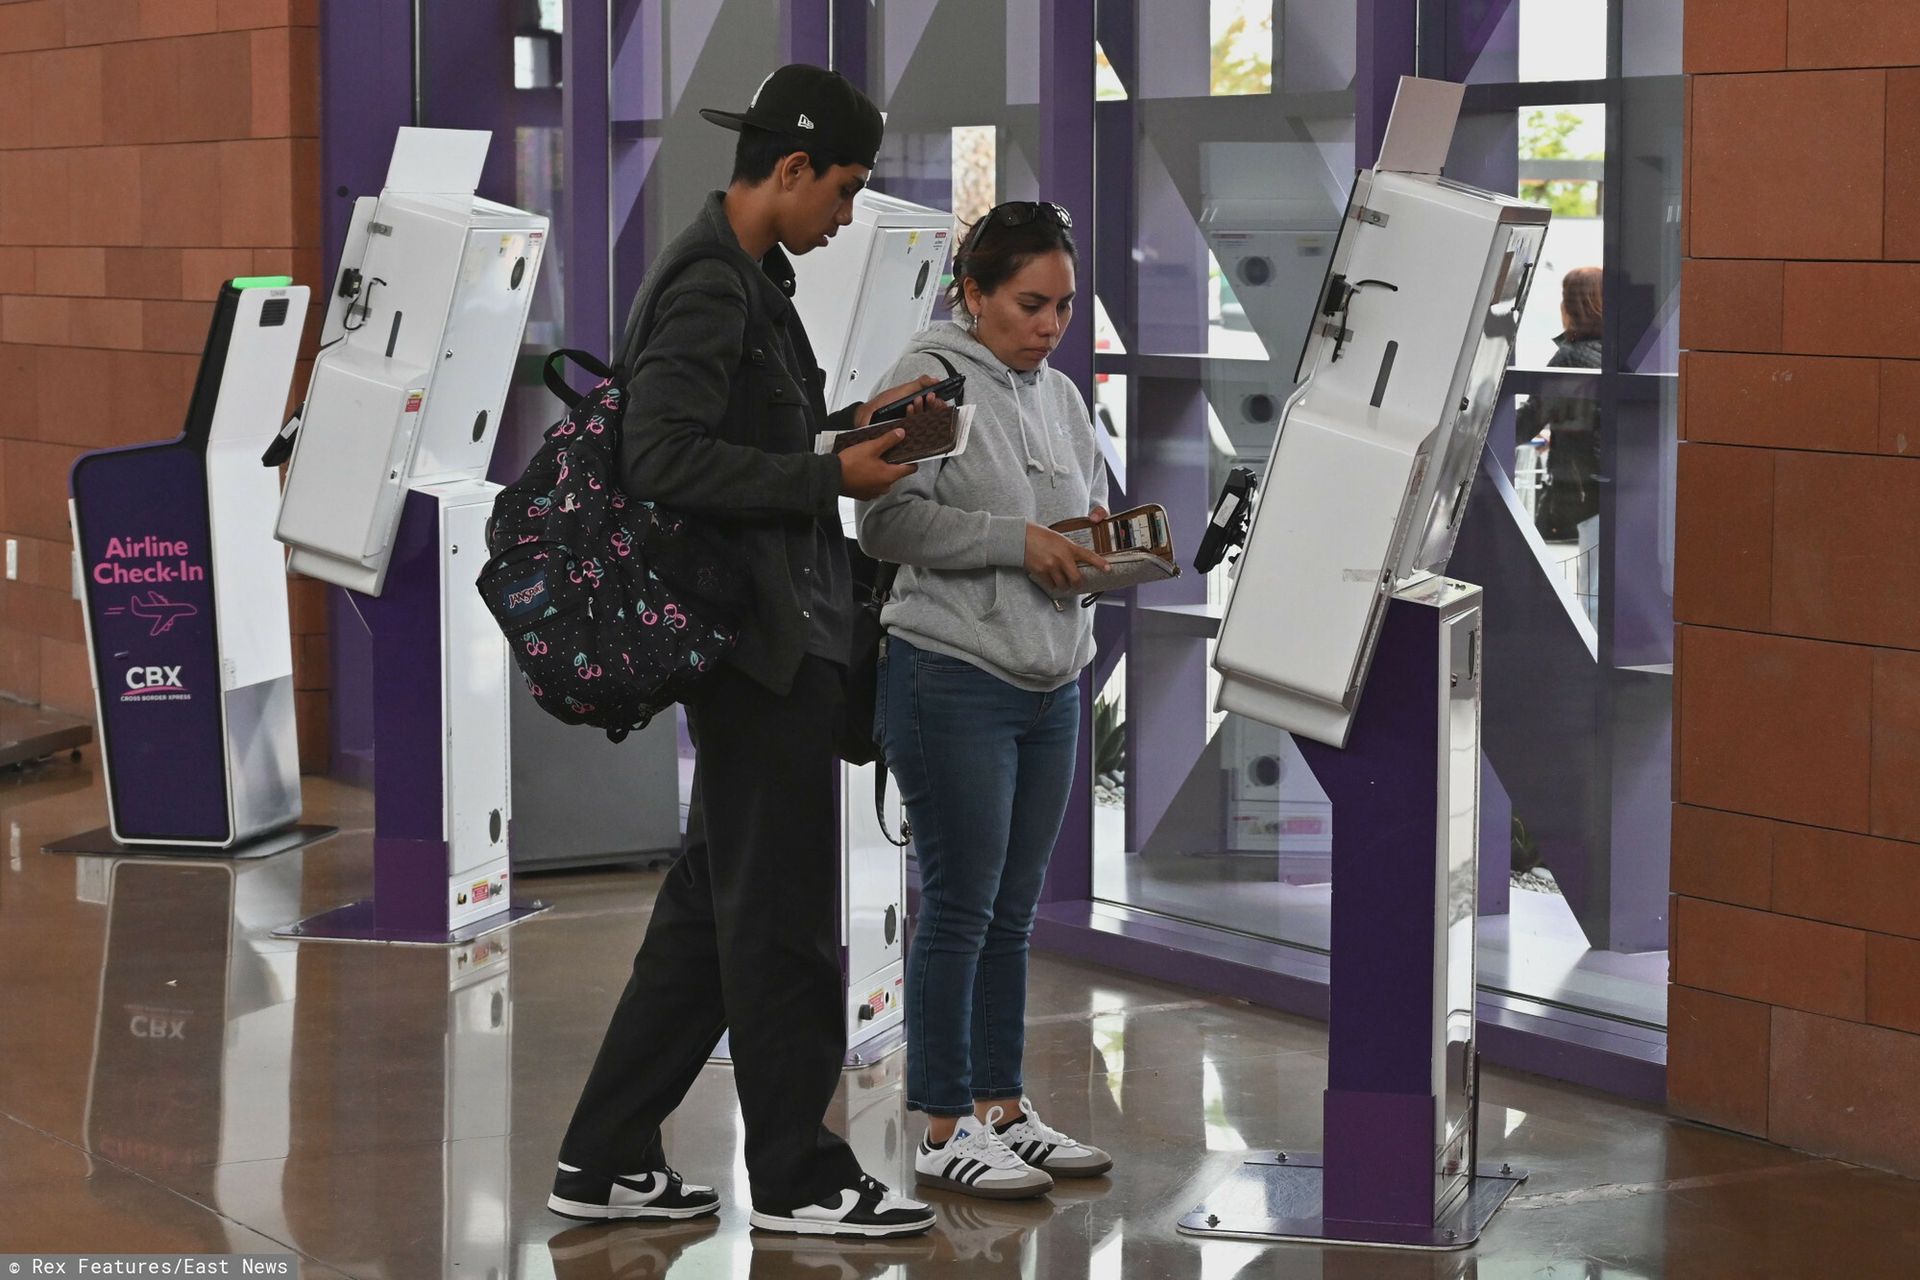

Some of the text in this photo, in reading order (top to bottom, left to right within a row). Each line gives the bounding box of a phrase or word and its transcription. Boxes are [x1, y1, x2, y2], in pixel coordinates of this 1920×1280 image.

[105, 536, 189, 558] Airline
[93, 560, 204, 584] Check-In
[126, 666, 183, 689] CBX
